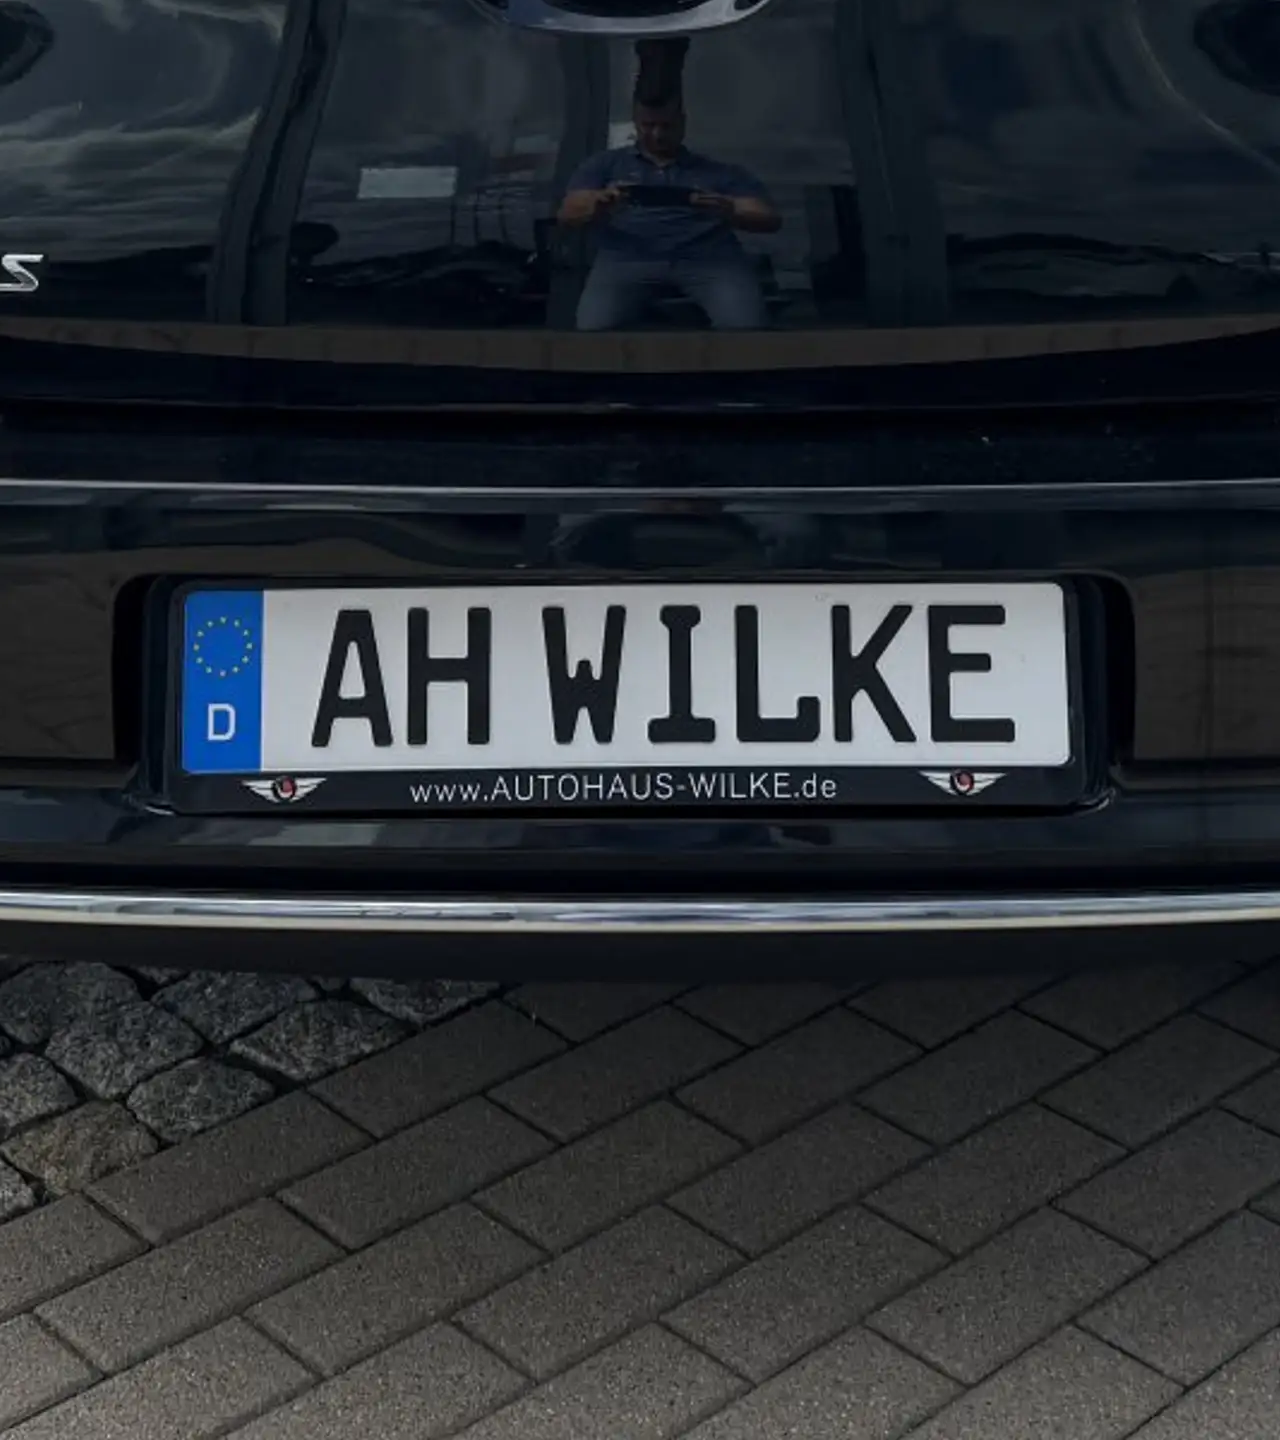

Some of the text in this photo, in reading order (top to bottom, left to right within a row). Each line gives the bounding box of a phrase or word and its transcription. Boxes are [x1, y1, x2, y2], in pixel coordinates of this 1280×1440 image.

[310, 603, 1017, 749] AH WILKE
[206, 702, 237, 743] D
[409, 771, 838, 803] www.AUTOHAUS-WILKE.de
